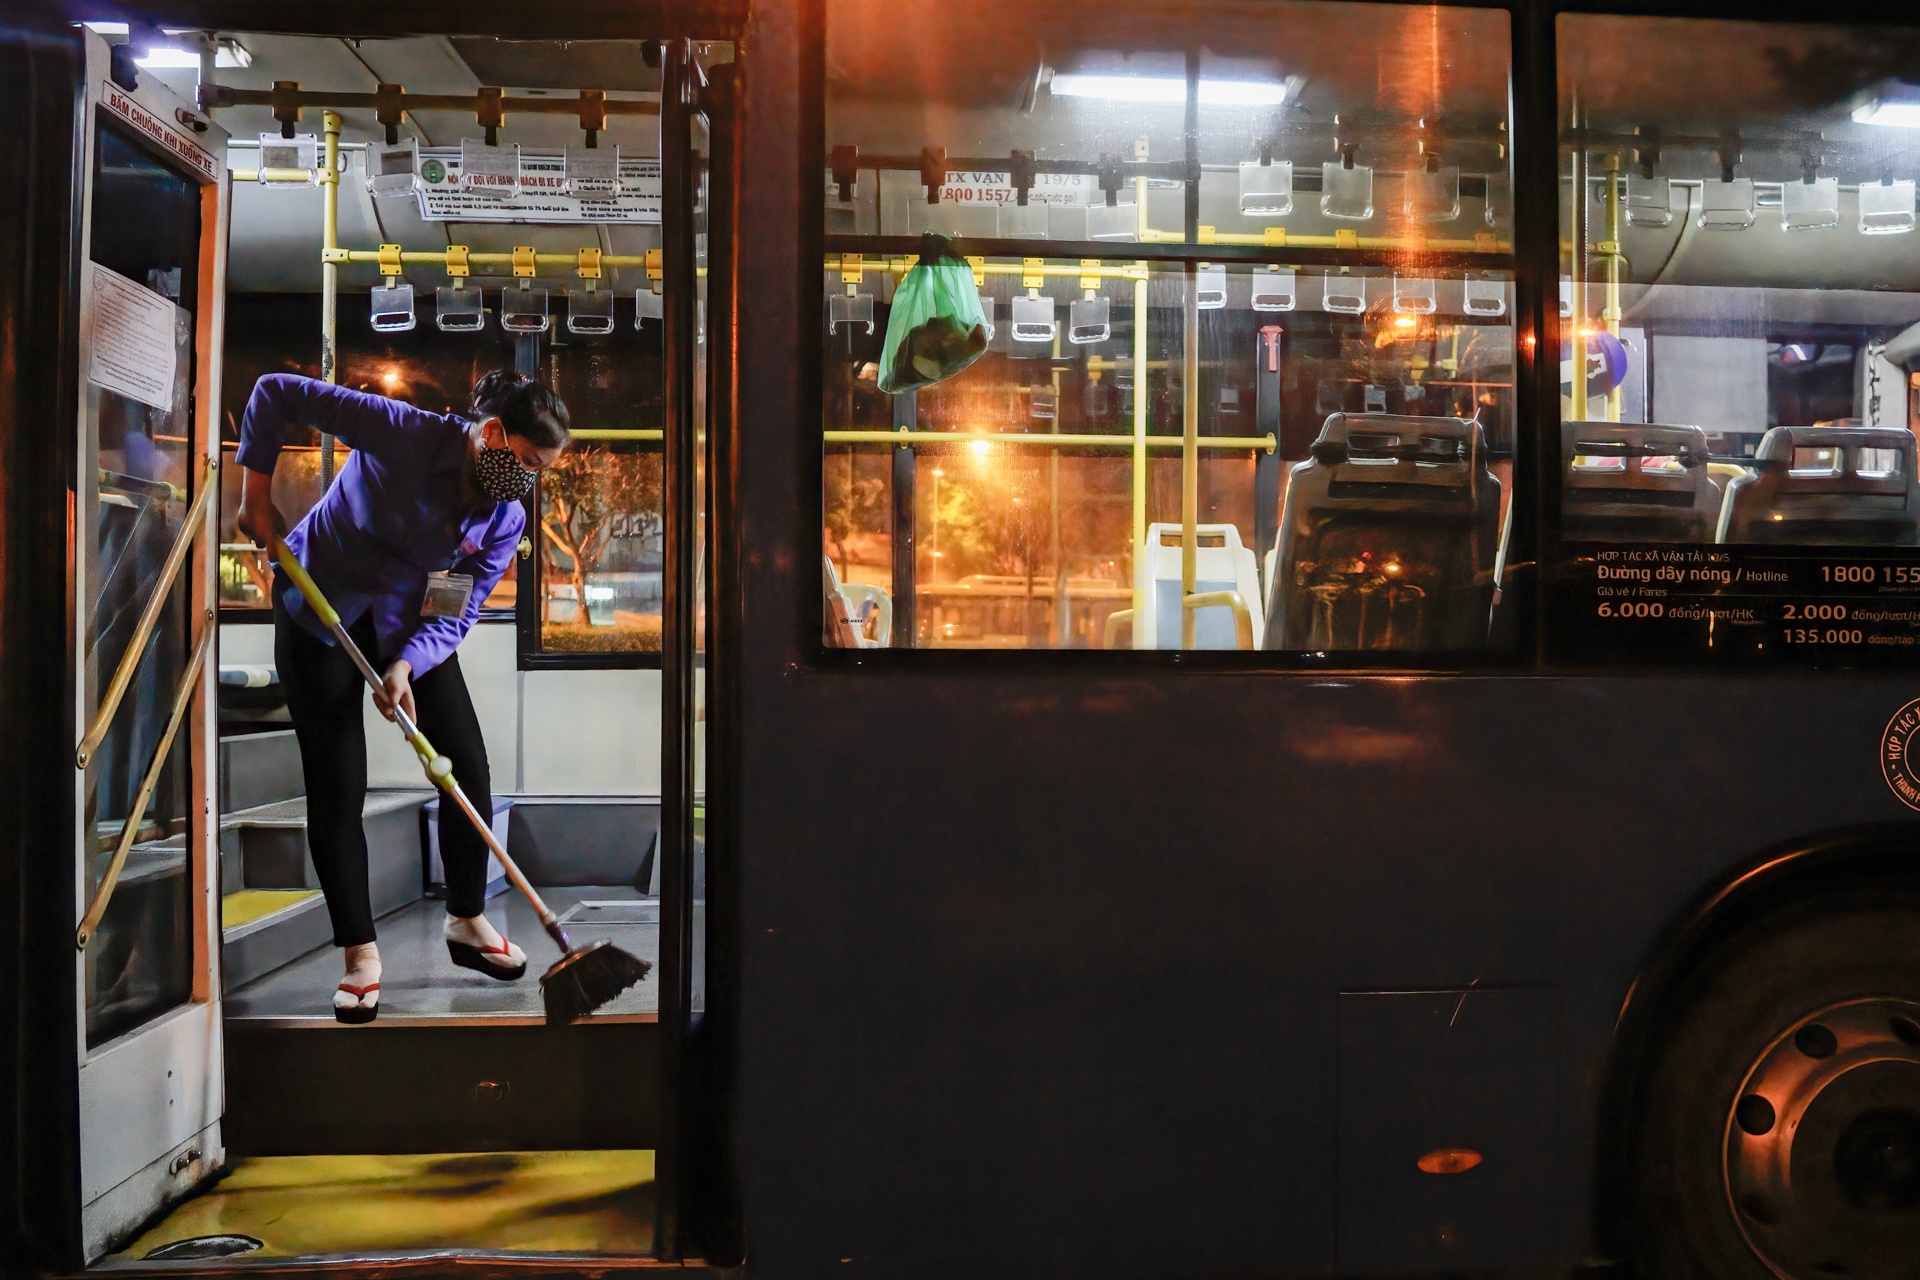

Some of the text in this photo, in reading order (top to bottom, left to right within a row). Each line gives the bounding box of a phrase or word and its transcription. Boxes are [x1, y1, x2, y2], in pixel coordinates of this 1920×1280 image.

[131, 108, 163, 139] CHUÔNG
[164, 130, 178, 150] KHI
[203, 154, 213, 174] XE
[519, 174, 538, 187] HÁCH
[946, 172, 967, 184] TX
[1043, 174, 1082, 187] 19/5
[977, 188, 1013, 203] 1557
[1622, 549, 1643, 562] TÁC
[1644, 549, 1661, 562] XÃ
[1597, 564, 1651, 583] Đường
[1655, 564, 1686, 583] dây
[1690, 566, 1731, 584] nóng
[1746, 570, 1789, 582] Hotline
[1821, 565, 1876, 583] 1800
[1597, 586, 1614, 597] Giá
[1639, 586, 1668, 598] Fares
[1597, 602, 1665, 618] 6.000
[1782, 604, 1847, 620] 2.000
[1783, 629, 1863, 645] 135.000
